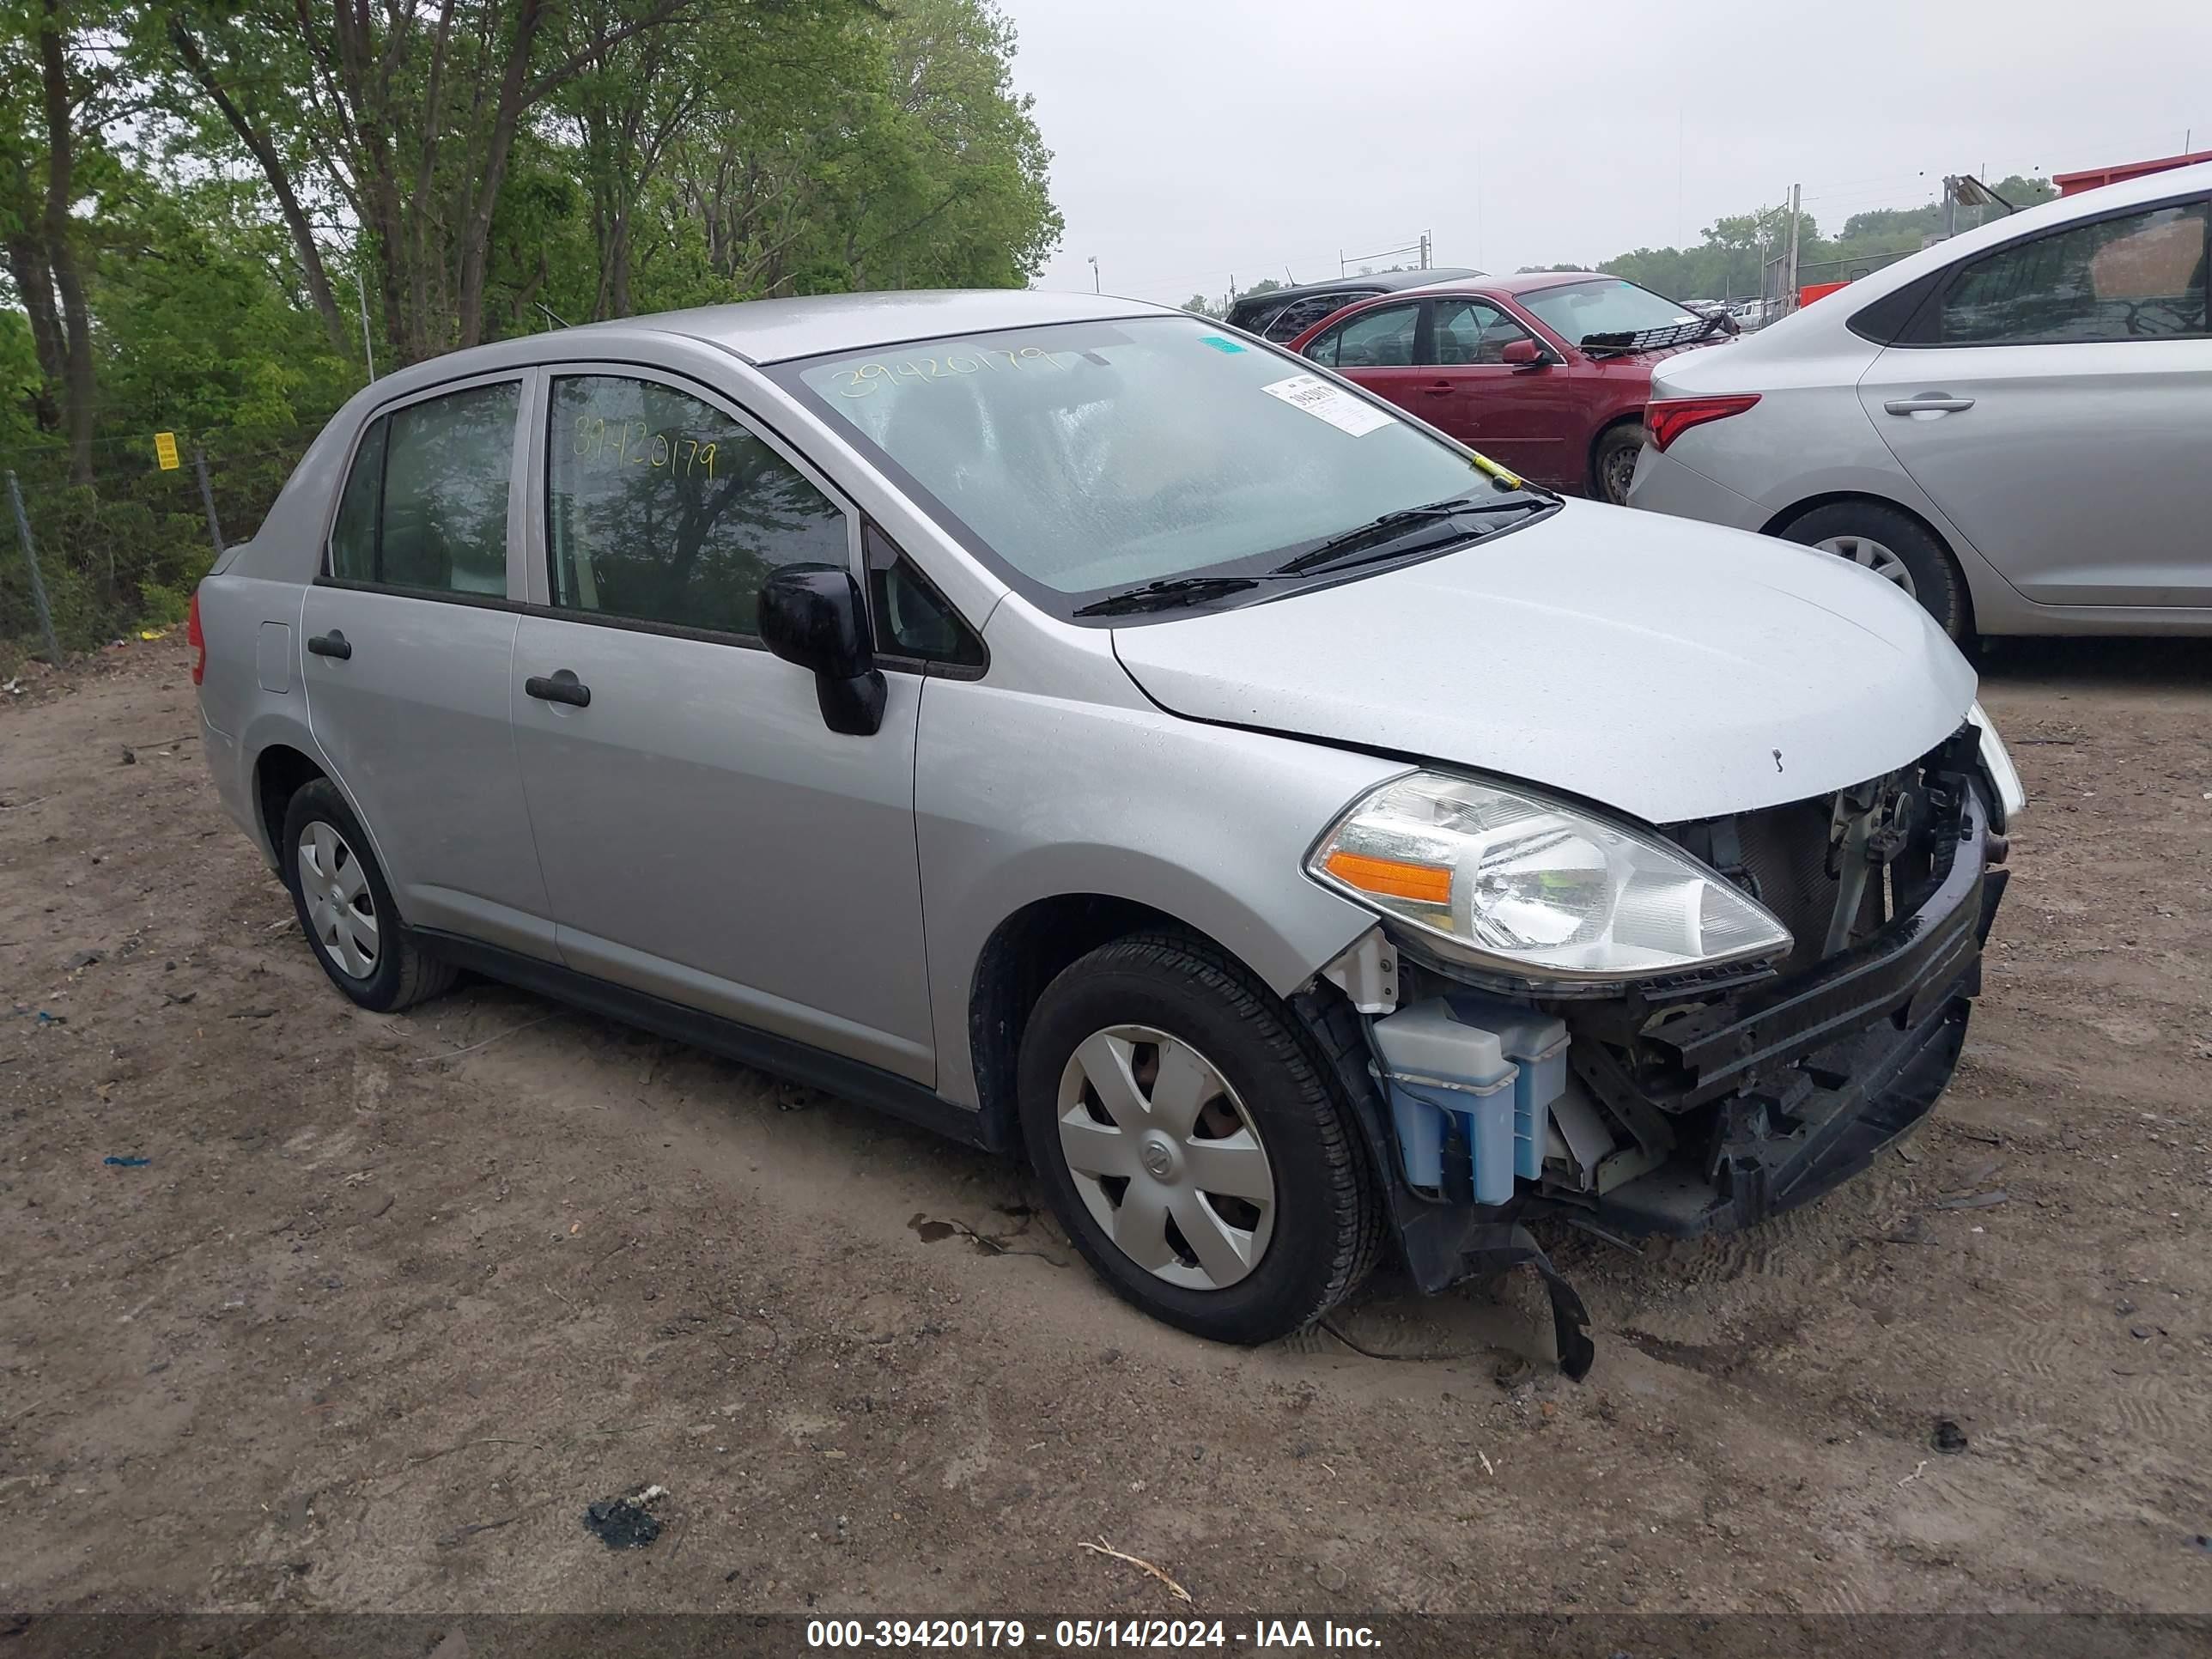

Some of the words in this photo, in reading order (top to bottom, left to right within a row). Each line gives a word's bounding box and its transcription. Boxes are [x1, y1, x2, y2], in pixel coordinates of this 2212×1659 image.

[831, 347, 1066, 398] 39420179
[1289, 385, 1339, 406] 39420179
[573, 416, 718, 483] 39420179
